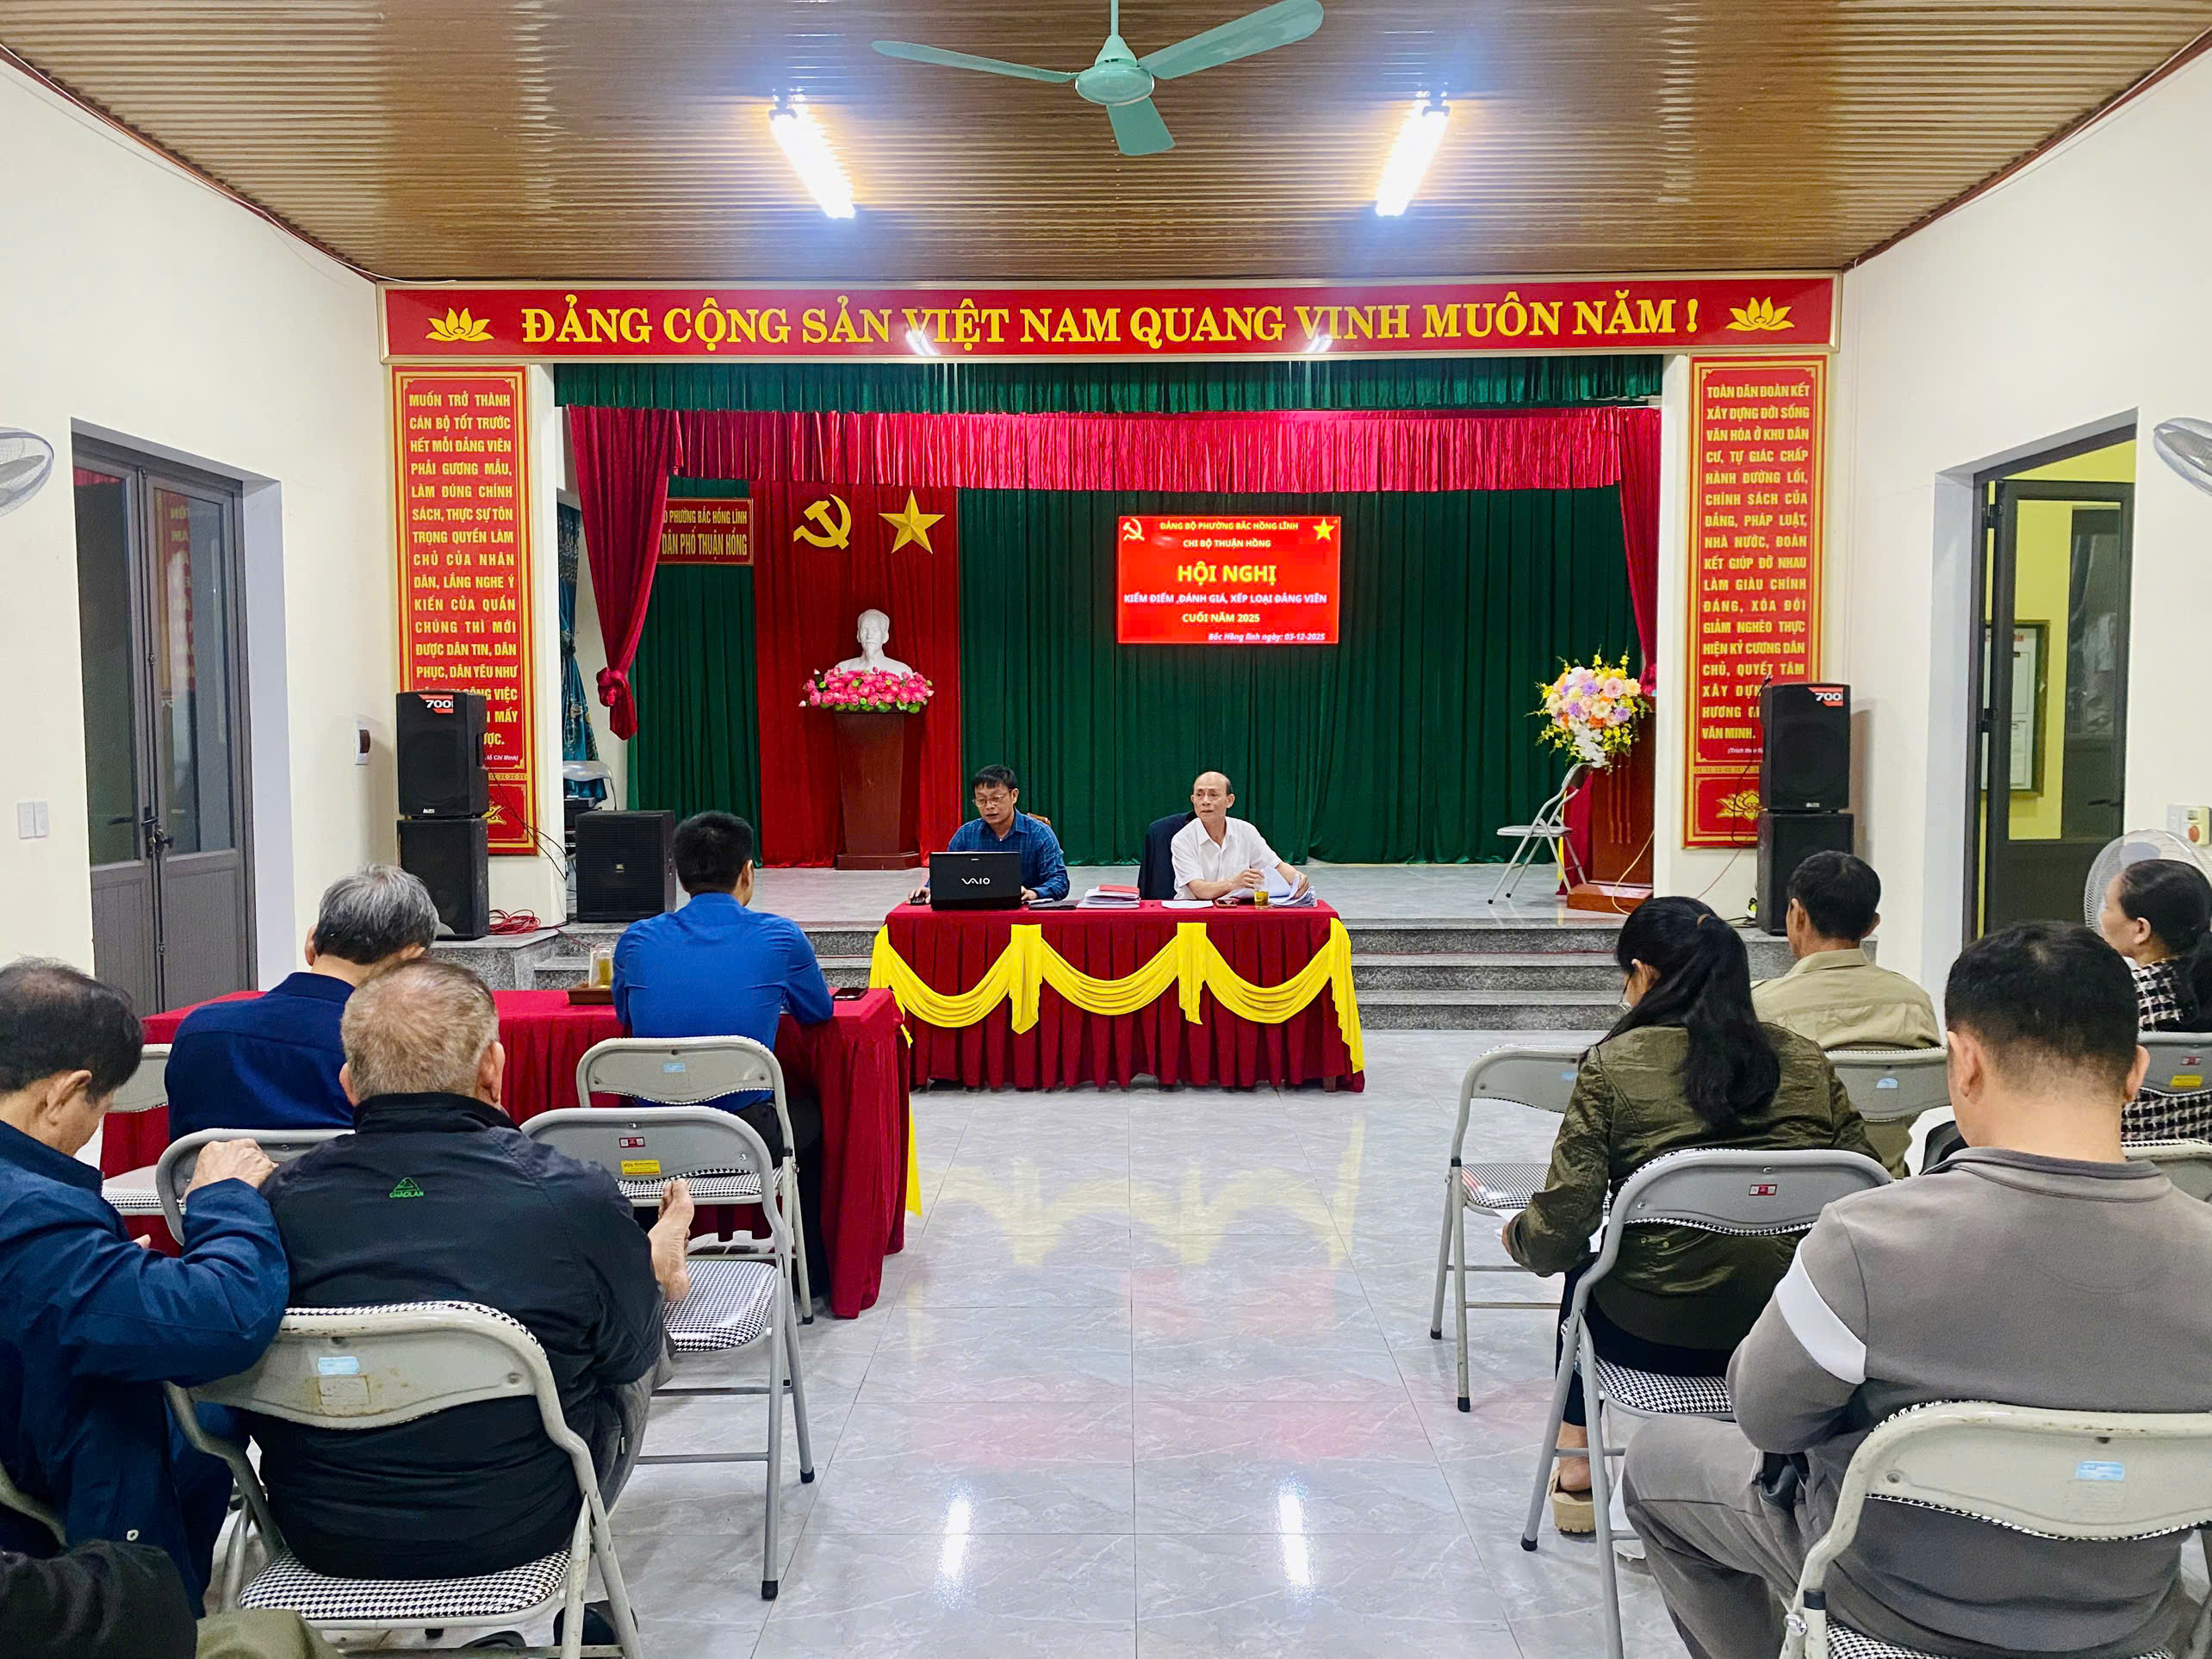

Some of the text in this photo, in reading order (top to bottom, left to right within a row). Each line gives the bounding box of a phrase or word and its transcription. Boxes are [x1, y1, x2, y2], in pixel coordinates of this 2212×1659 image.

[521, 289, 1698, 351] ĐẢNG CỘNG SẢN VIỆT NAM QUANG VINH MUÔN NĂM !
[1707, 382, 1810, 398] TOÀN DÂN ĐOÀN KẾT
[409, 391, 510, 407] MUỐN TRỞ THÀNH
[1706, 403, 1810, 422] XÂY DỰNG ĐỜI SỐNG
[410, 413, 511, 432] CÁN BỘ TỐT TRƯỚC
[1706, 426, 1809, 441] VĂN HÓA Ở KHU DÂN
[410, 436, 511, 452] HẾT MỖI ĐẢNG VIÊN
[1706, 447, 1808, 465] CƯ, TỰ GIÁC CHẤP
[411, 458, 512, 475] PHẢI GƯƠNG MẪU,
[1706, 468, 1807, 484] HÀNH ĐƯỜNG LỐI,
[412, 483, 513, 498] LÀM ĐÚNG CHÍNH
[1706, 489, 1807, 506] CHÍNH SÁCH CỦA
[413, 506, 513, 523] SÁCH, THỰC SỰ TÔN
[669, 507, 696, 524] PHƯỜNG
[1705, 512, 1806, 528] ĐẢNG, PHÁP LUẬT,
[1159, 520, 1183, 530] ĐẢNG
[1185, 521, 1196, 531] BỘ
[1198, 520, 1233, 530] PHƯỜNG
[1253, 520, 1277, 530] HỒNG
[413, 531, 447, 545] TRỌNG
[491, 529, 513, 543] LÀM
[662, 529, 678, 555] DÂN
[680, 525, 696, 555] PHỐ
[698, 529, 724, 560] THUẬN
[1200, 538, 1212, 549] BỘ
[1214, 538, 1243, 549] THUẬN
[1246, 538, 1271, 548] HỒNG
[1705, 534, 1806, 549] NHÀ NƯỚC, ĐOÀN
[413, 550, 514, 565] CHỦ CỦA NHÂN
[1705, 555, 1806, 569] KẾT GIÚP ĐỠ NHAU
[414, 572, 514, 589] DÂN, LẮNG NGHE Ý
[1177, 561, 1277, 586] HỘI NGHỊ
[1704, 576, 1806, 591] LÀM GIÀU CHÍNH
[414, 595, 443, 611] KIẾN
[451, 595, 475, 611] CỦA
[1230, 592, 1247, 603] XẾP
[1251, 594, 1272, 605] LOẠI
[1274, 593, 1302, 603] ĐẢNG
[1303, 593, 1327, 603] VIÊN
[1703, 598, 1805, 613] ĐÁNG, XÓA ĐÓI
[1183, 612, 1260, 623] CUỐI NĂM 2025
[415, 619, 516, 633] CHÚNG THÌ MỚI
[1703, 618, 1805, 634] GIẢM NGHÈO THỰC
[416, 642, 516, 658] ĐƯỢC DÂN TIN, DÂN
[1703, 641, 1728, 656] HIỆN
[1746, 643, 1780, 654] CƯƠNG
[1783, 641, 1805, 654] DÂN
[417, 664, 518, 680] PHỤC, DÂN YÊU NHƯ
[1737, 661, 1774, 678] QUYẾT
[1780, 662, 1805, 674] TÂM
[494, 687, 518, 702] VIỆC
[1702, 683, 1762, 699] XÂY DỰN
[495, 707, 518, 722] MẤY
[1702, 706, 1742, 718] HƯƠNG
[1702, 726, 1723, 739] VĂN
